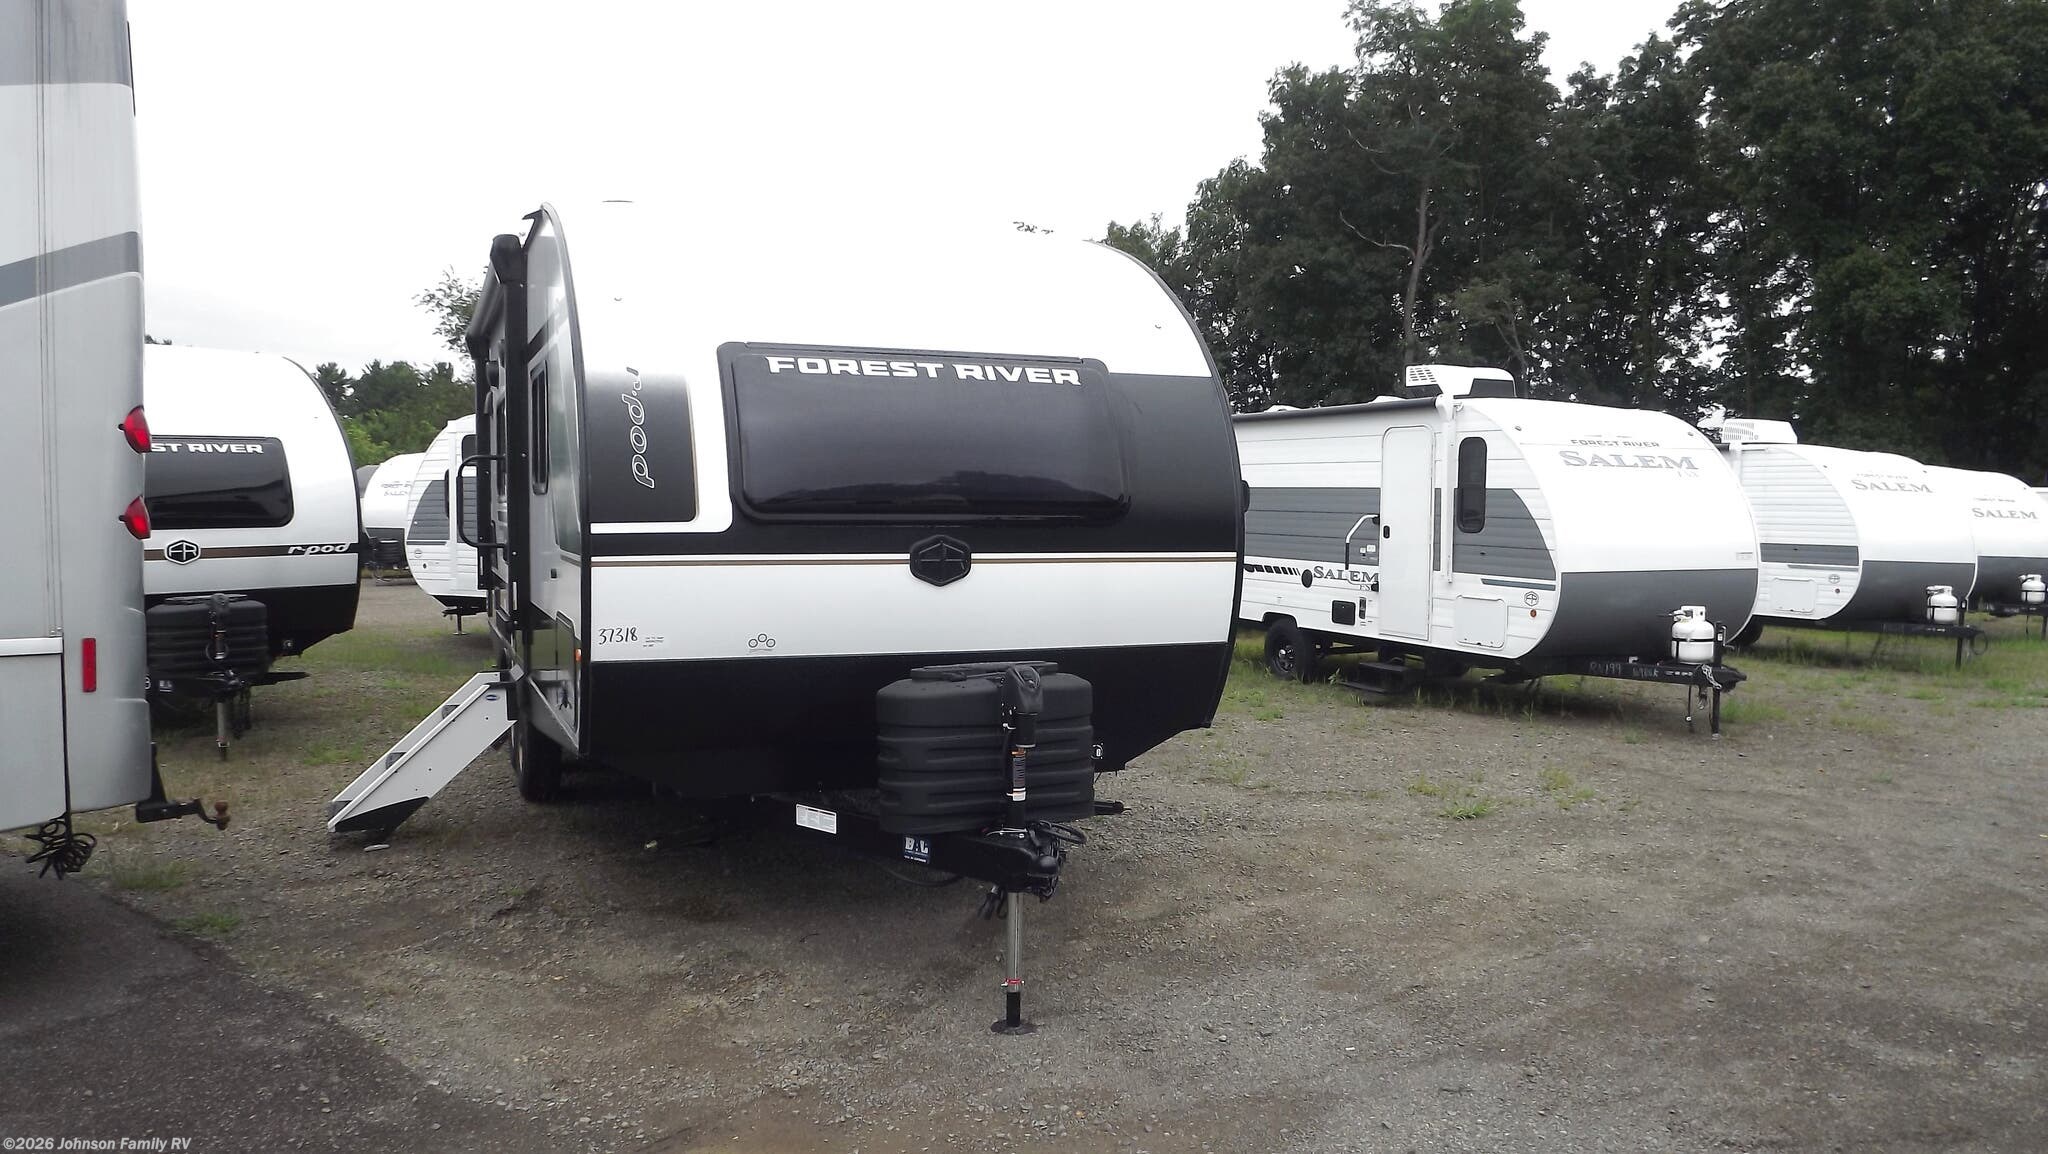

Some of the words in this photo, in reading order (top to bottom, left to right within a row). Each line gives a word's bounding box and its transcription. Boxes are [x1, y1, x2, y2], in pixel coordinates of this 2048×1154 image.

[764, 356, 944, 378] FOREST
[951, 363, 1082, 386] RIVER
[186, 443, 264, 454] RIVER
[1558, 450, 1700, 470] SALEM
[1851, 479, 1935, 494] SALEM
[1971, 507, 2040, 520] SALEM
[1313, 565, 1379, 582] SALEM
[598, 626, 638, 645] 37318
